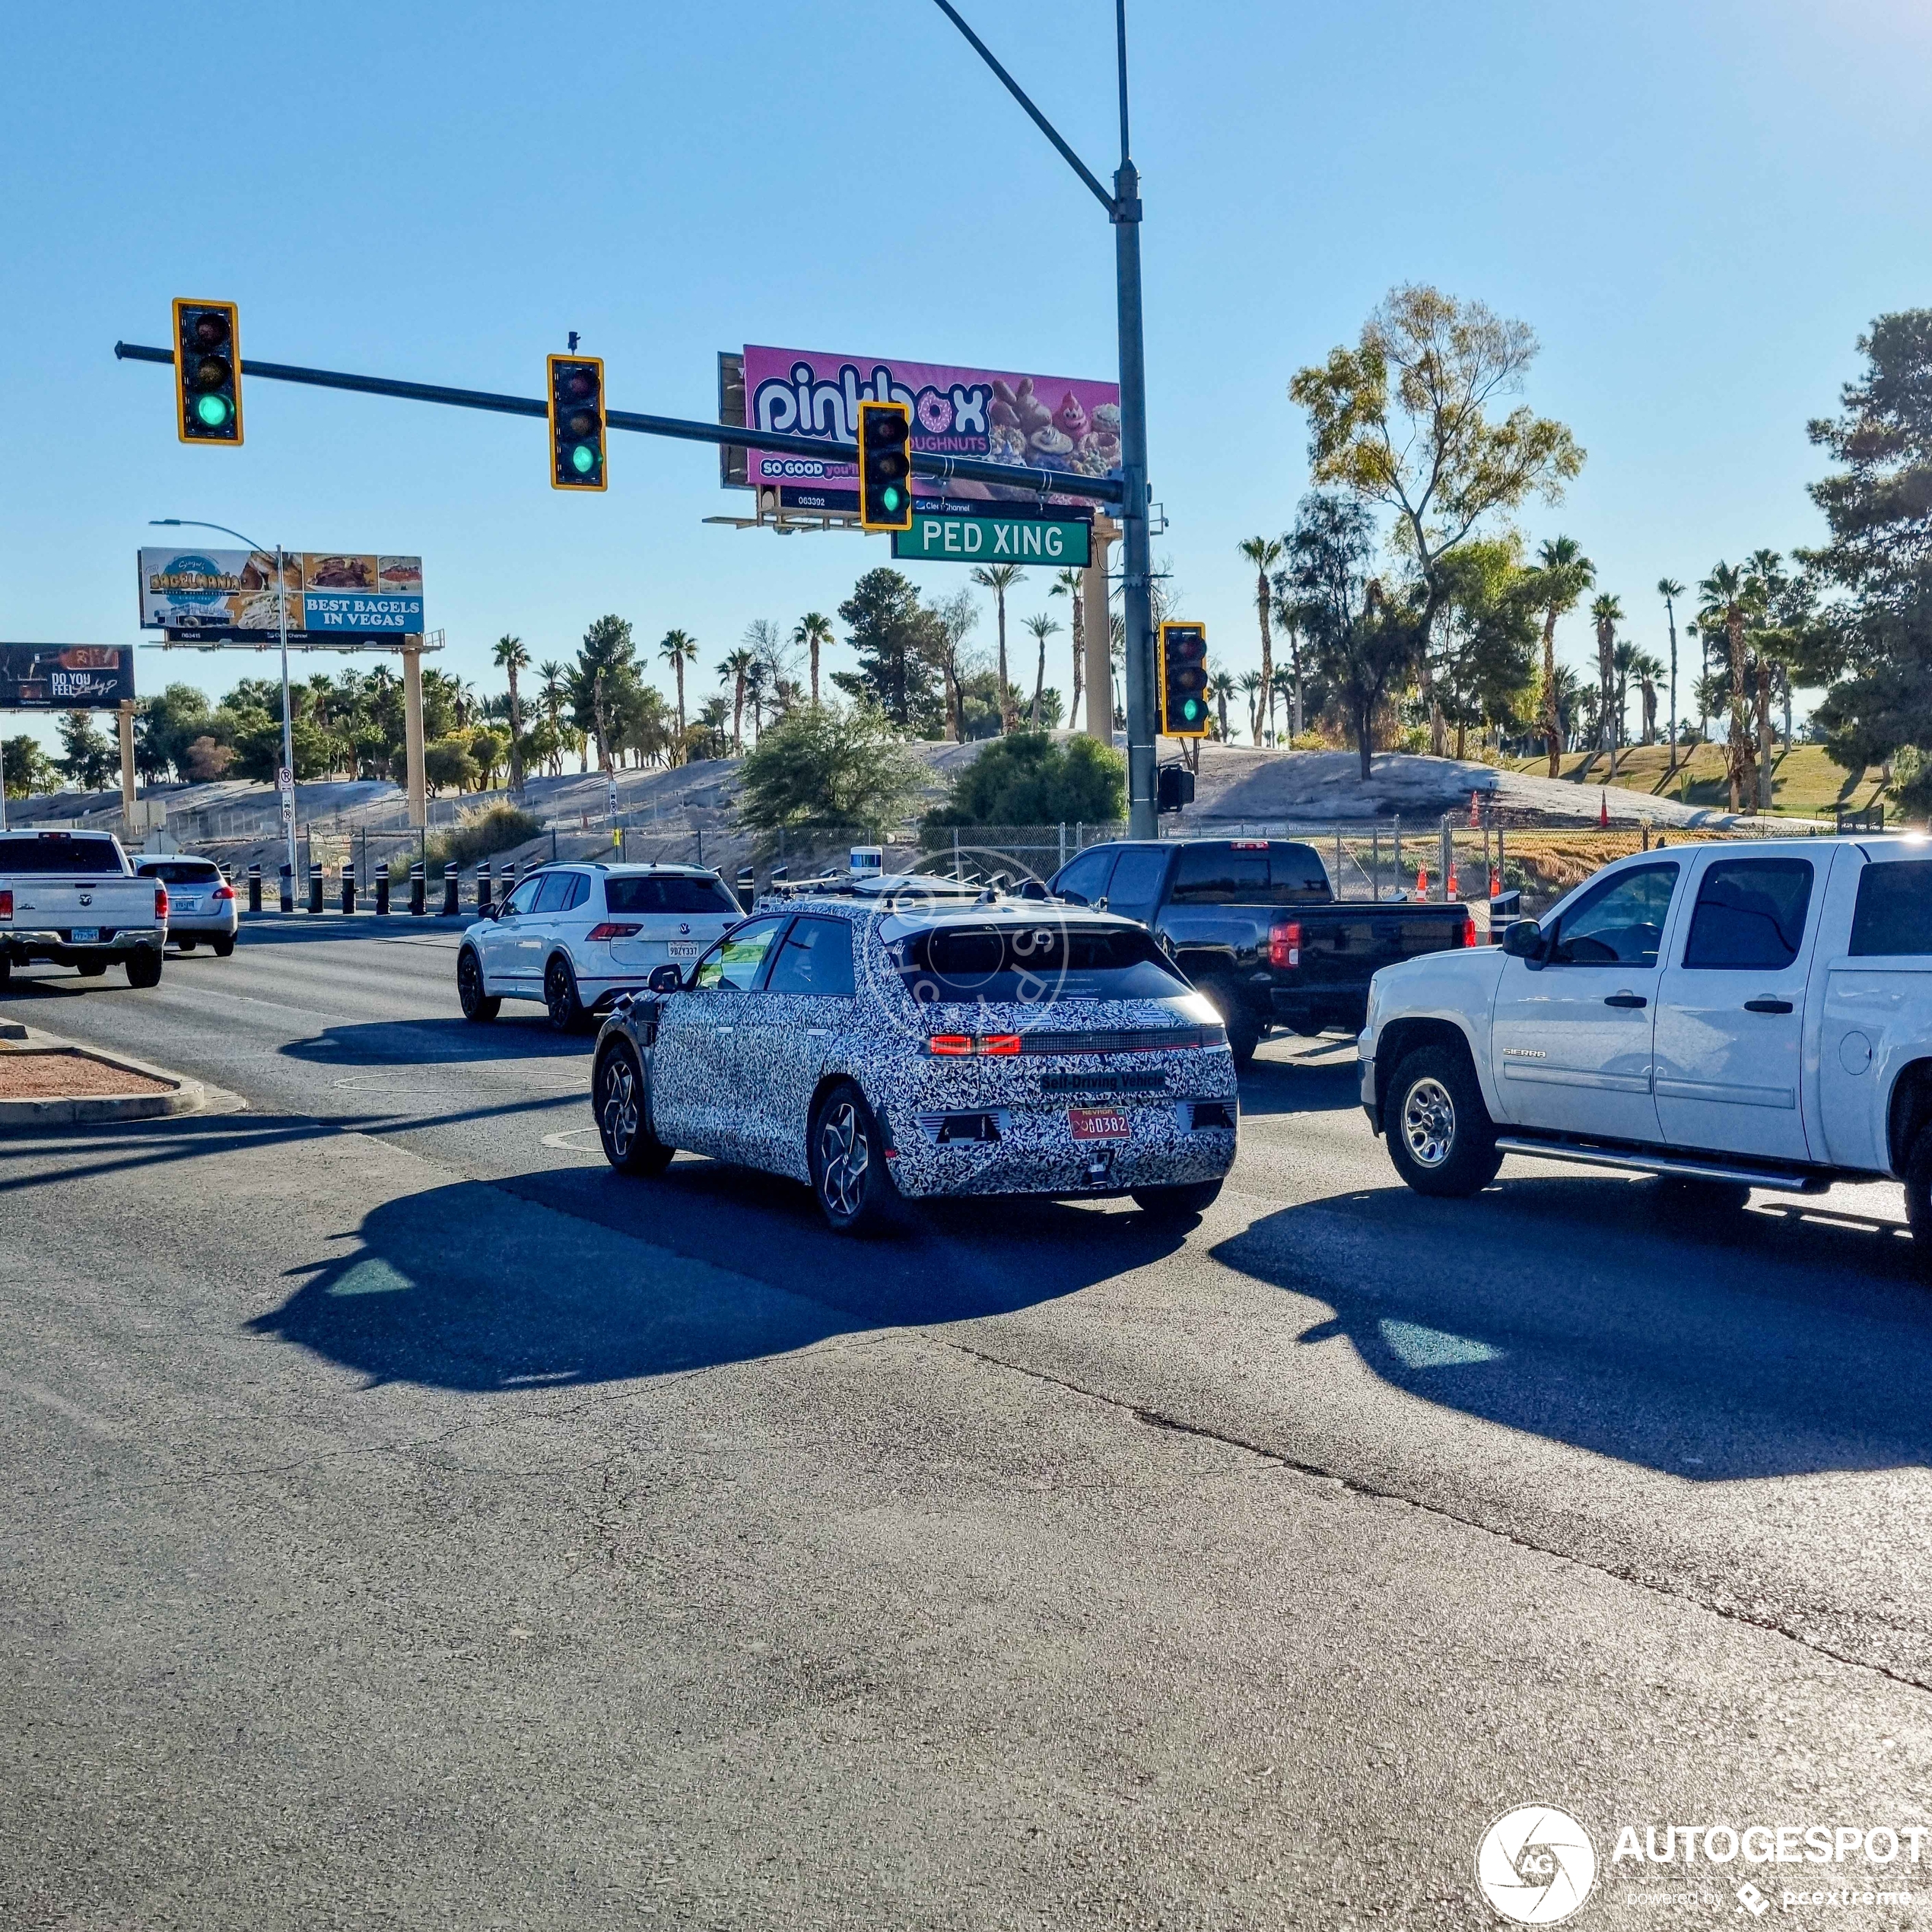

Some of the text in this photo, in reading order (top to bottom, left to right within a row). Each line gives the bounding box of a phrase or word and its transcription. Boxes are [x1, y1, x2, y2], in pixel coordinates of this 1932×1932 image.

[910, 437, 987, 451] UGHNUTS
[763, 462, 782, 474] SO
[785, 462, 823, 475] GOOD
[798, 497, 825, 507] 063392
[923, 520, 1063, 556] PED XING
[307, 599, 420, 614] BEST BAGELS
[323, 613, 405, 626] IN VEGAS
[52, 673, 91, 685] DO YOU
[52, 684, 75, 696] FEEL
[1503, 1048, 1546, 1058] SIERRA
[1042, 1072, 1165, 1091] Self-Driving Vehicle
